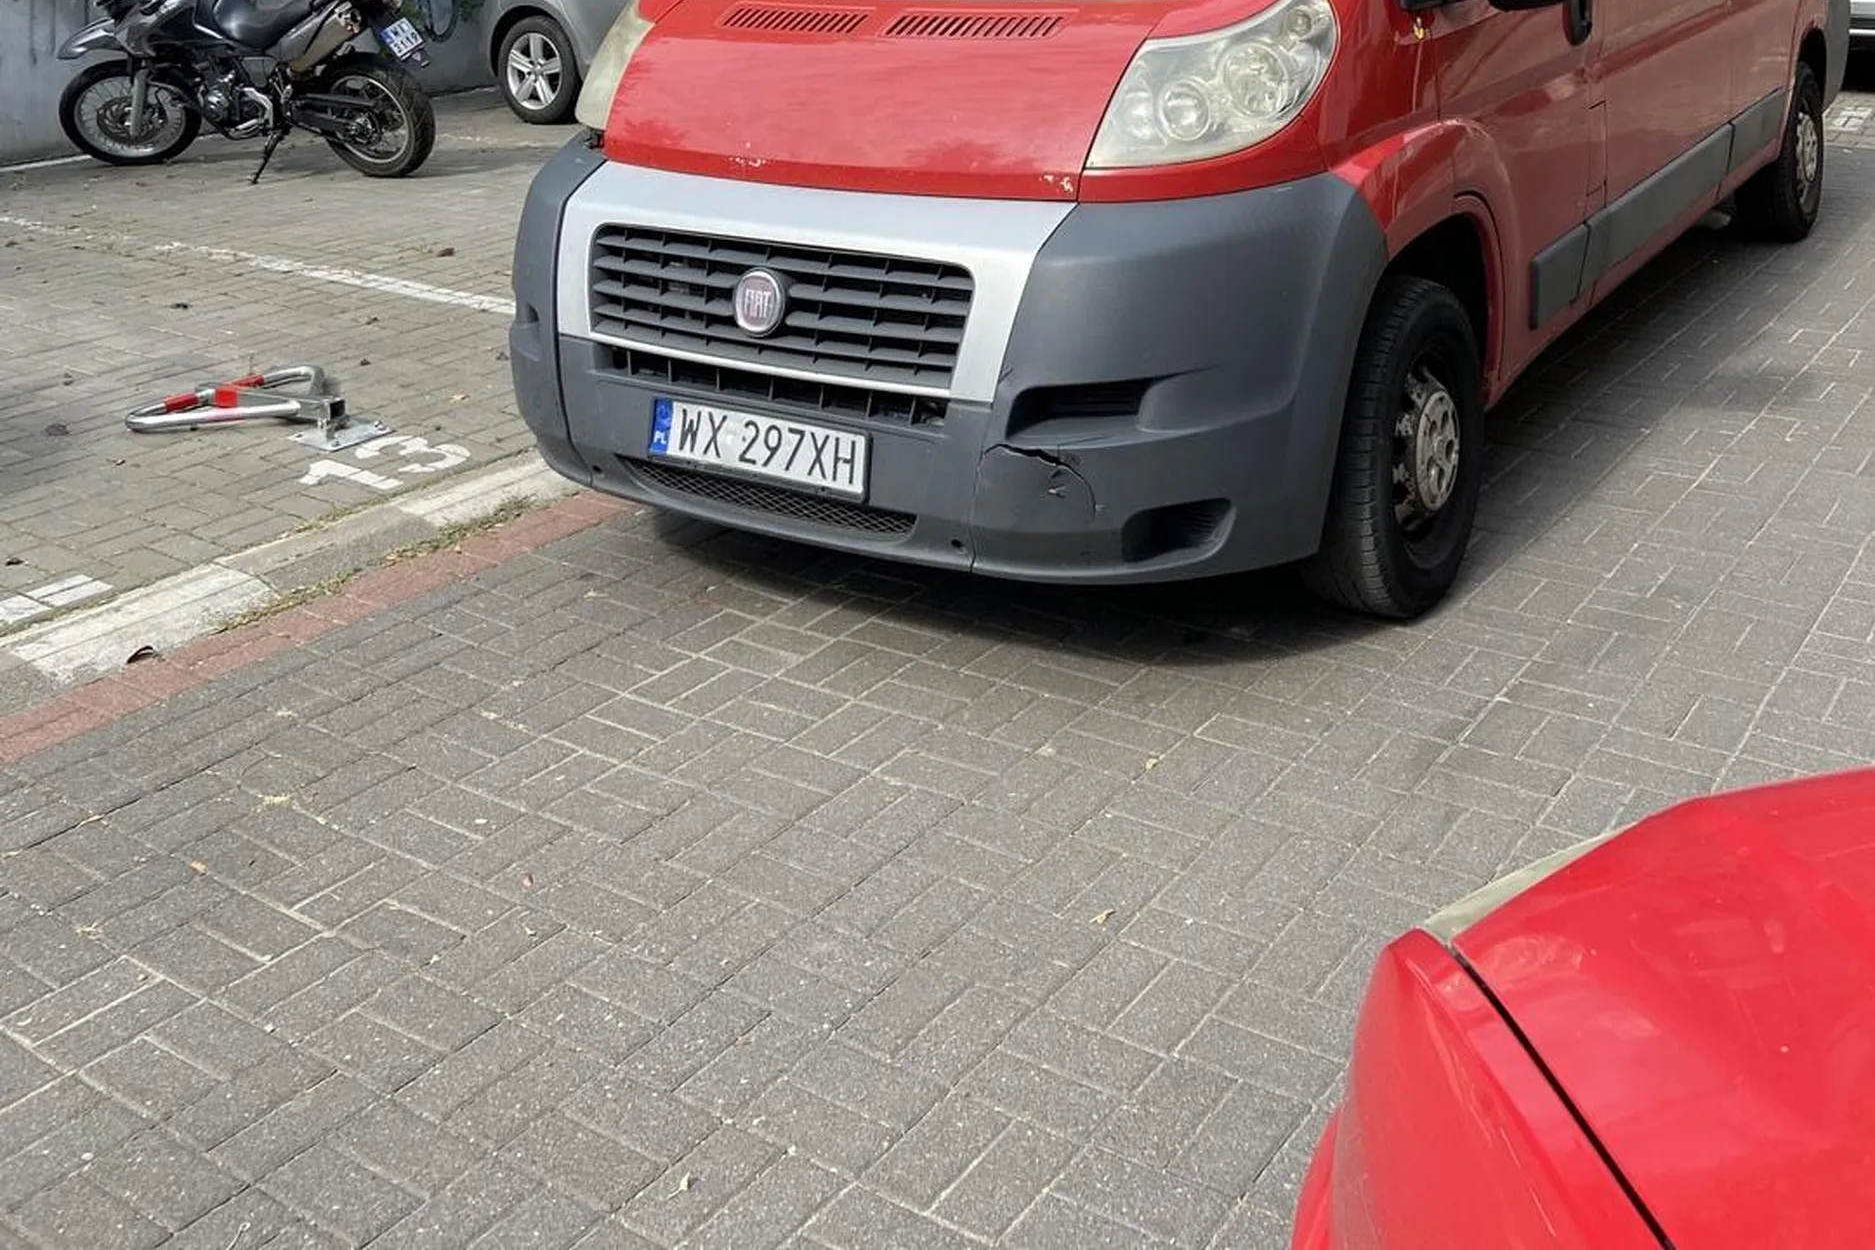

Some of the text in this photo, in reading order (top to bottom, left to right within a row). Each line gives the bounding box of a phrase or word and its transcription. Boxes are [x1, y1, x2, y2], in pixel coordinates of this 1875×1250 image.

[744, 289, 771, 318] FIAT
[653, 430, 667, 445] PL
[678, 407, 856, 485] WX 297XH
[298, 435, 472, 491] 13
